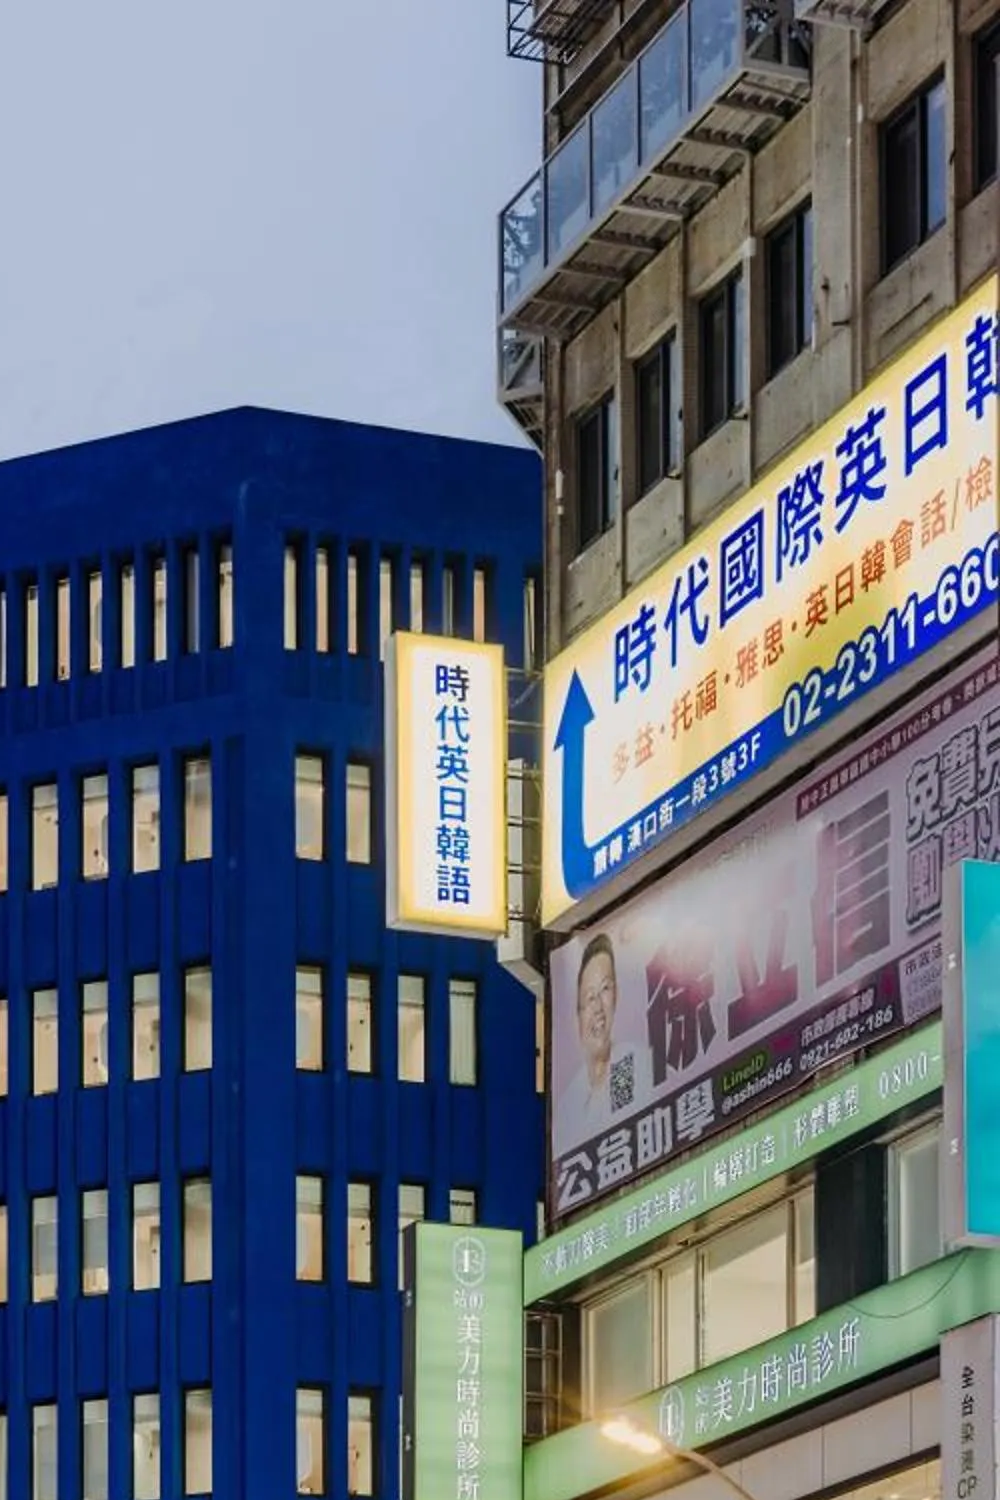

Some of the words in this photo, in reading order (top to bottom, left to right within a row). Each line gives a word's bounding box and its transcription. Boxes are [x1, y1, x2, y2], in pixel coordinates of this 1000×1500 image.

[435, 665, 470, 904] 時代英日韓語
[722, 1053, 764, 1091] LineID
[557, 1078, 715, 1211] 公益助學
[713, 1317, 860, 1427] 美力時尚診所
